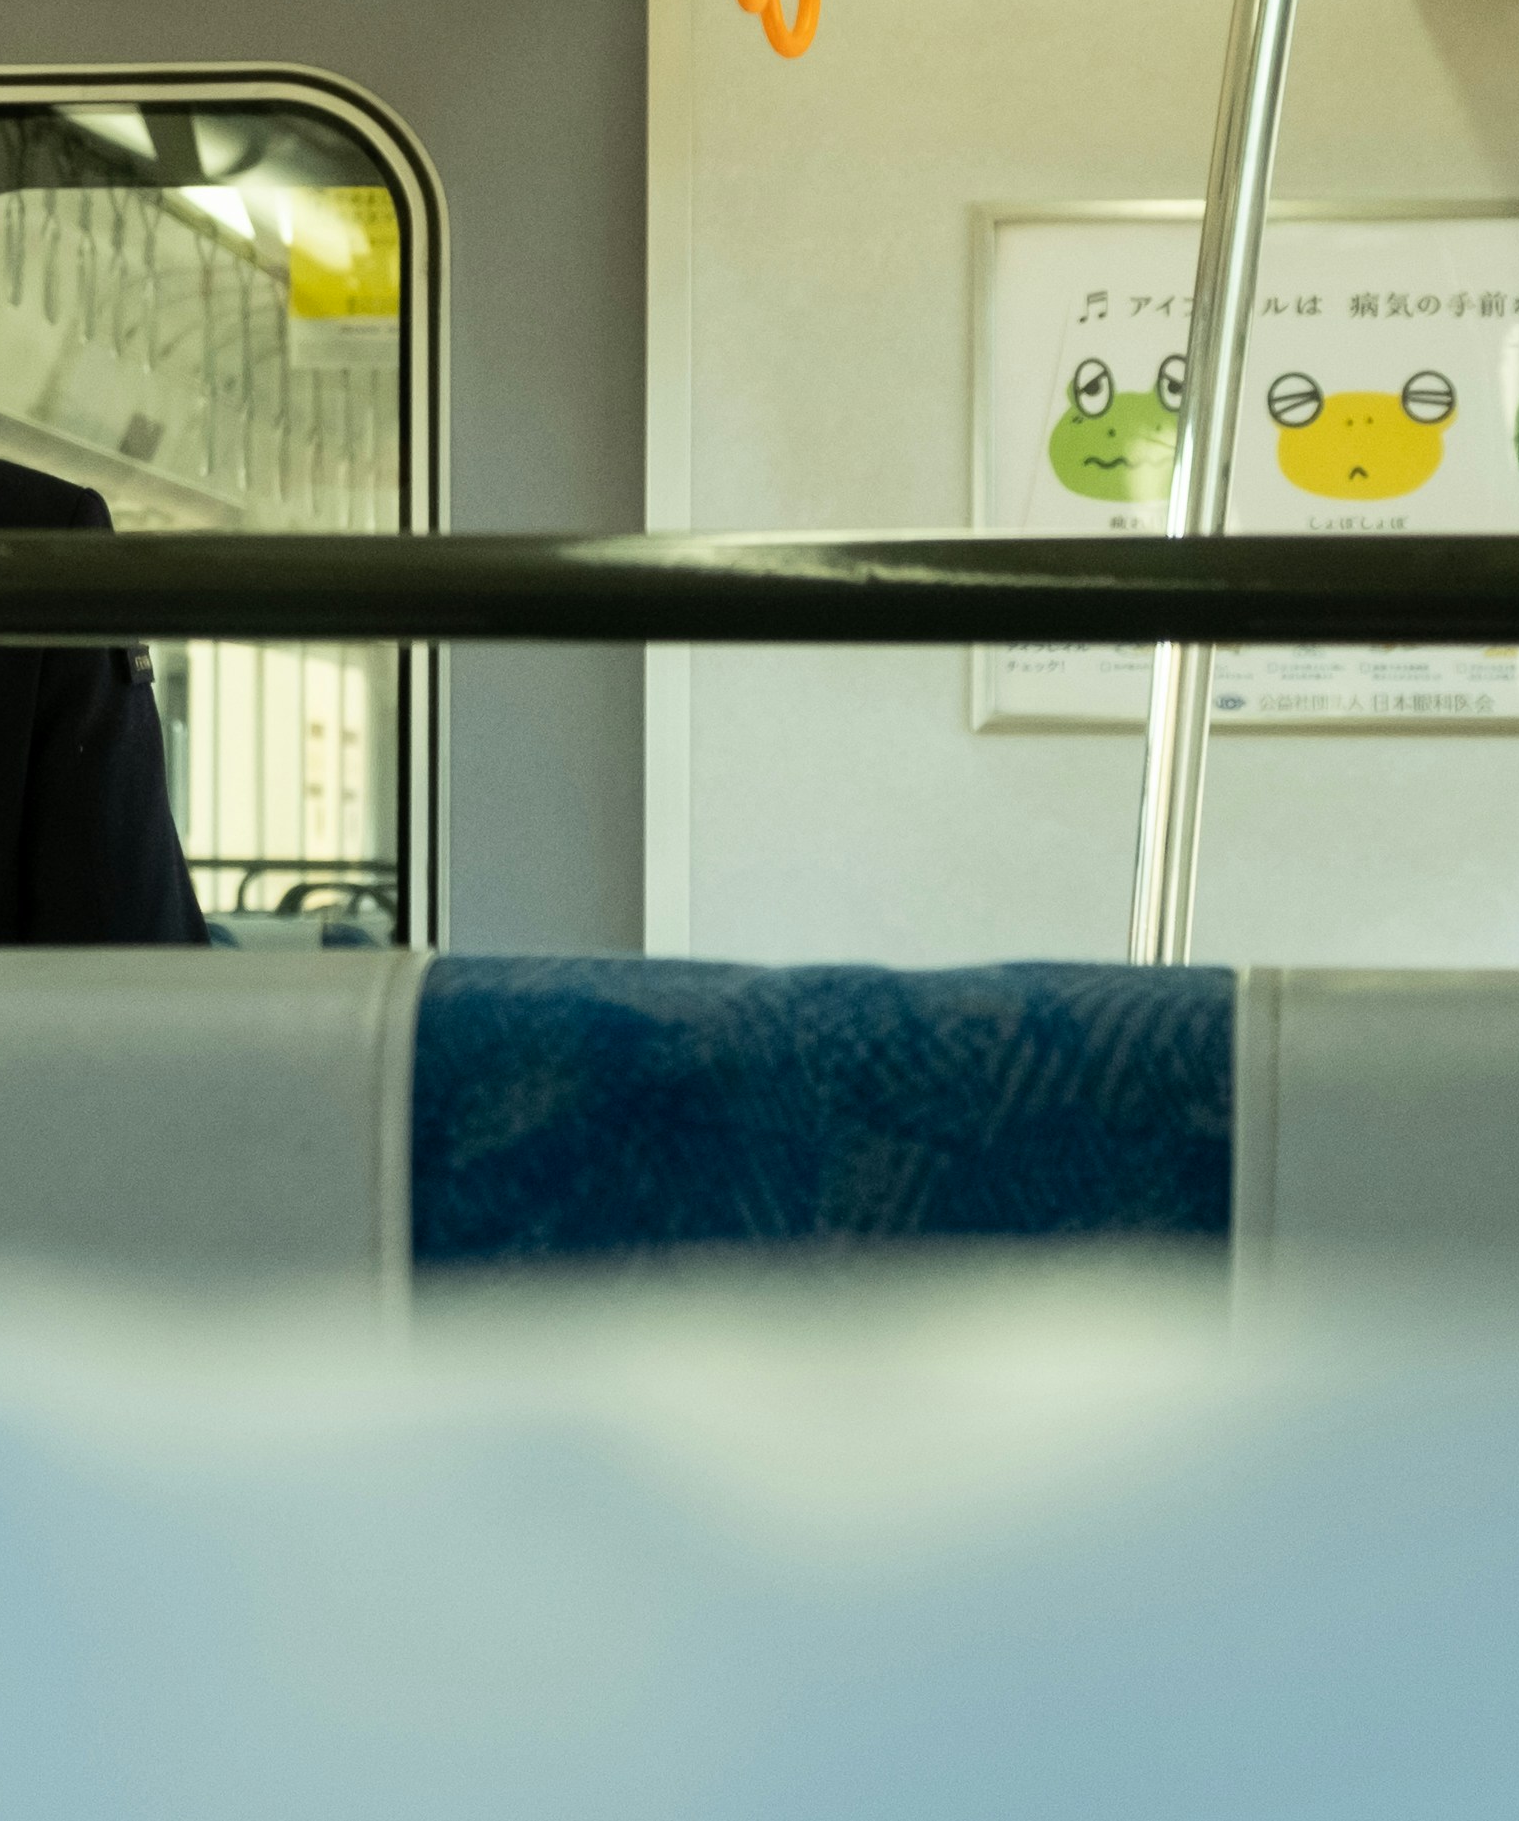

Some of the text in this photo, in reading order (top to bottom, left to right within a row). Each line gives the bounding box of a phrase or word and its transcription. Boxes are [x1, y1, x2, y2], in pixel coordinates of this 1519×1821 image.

[1130, 294, 1323, 318] アイルは
[1308, 515, 1407, 531] しょぼしょぼ
[1372, 693, 1496, 713] 日本眼科医会
